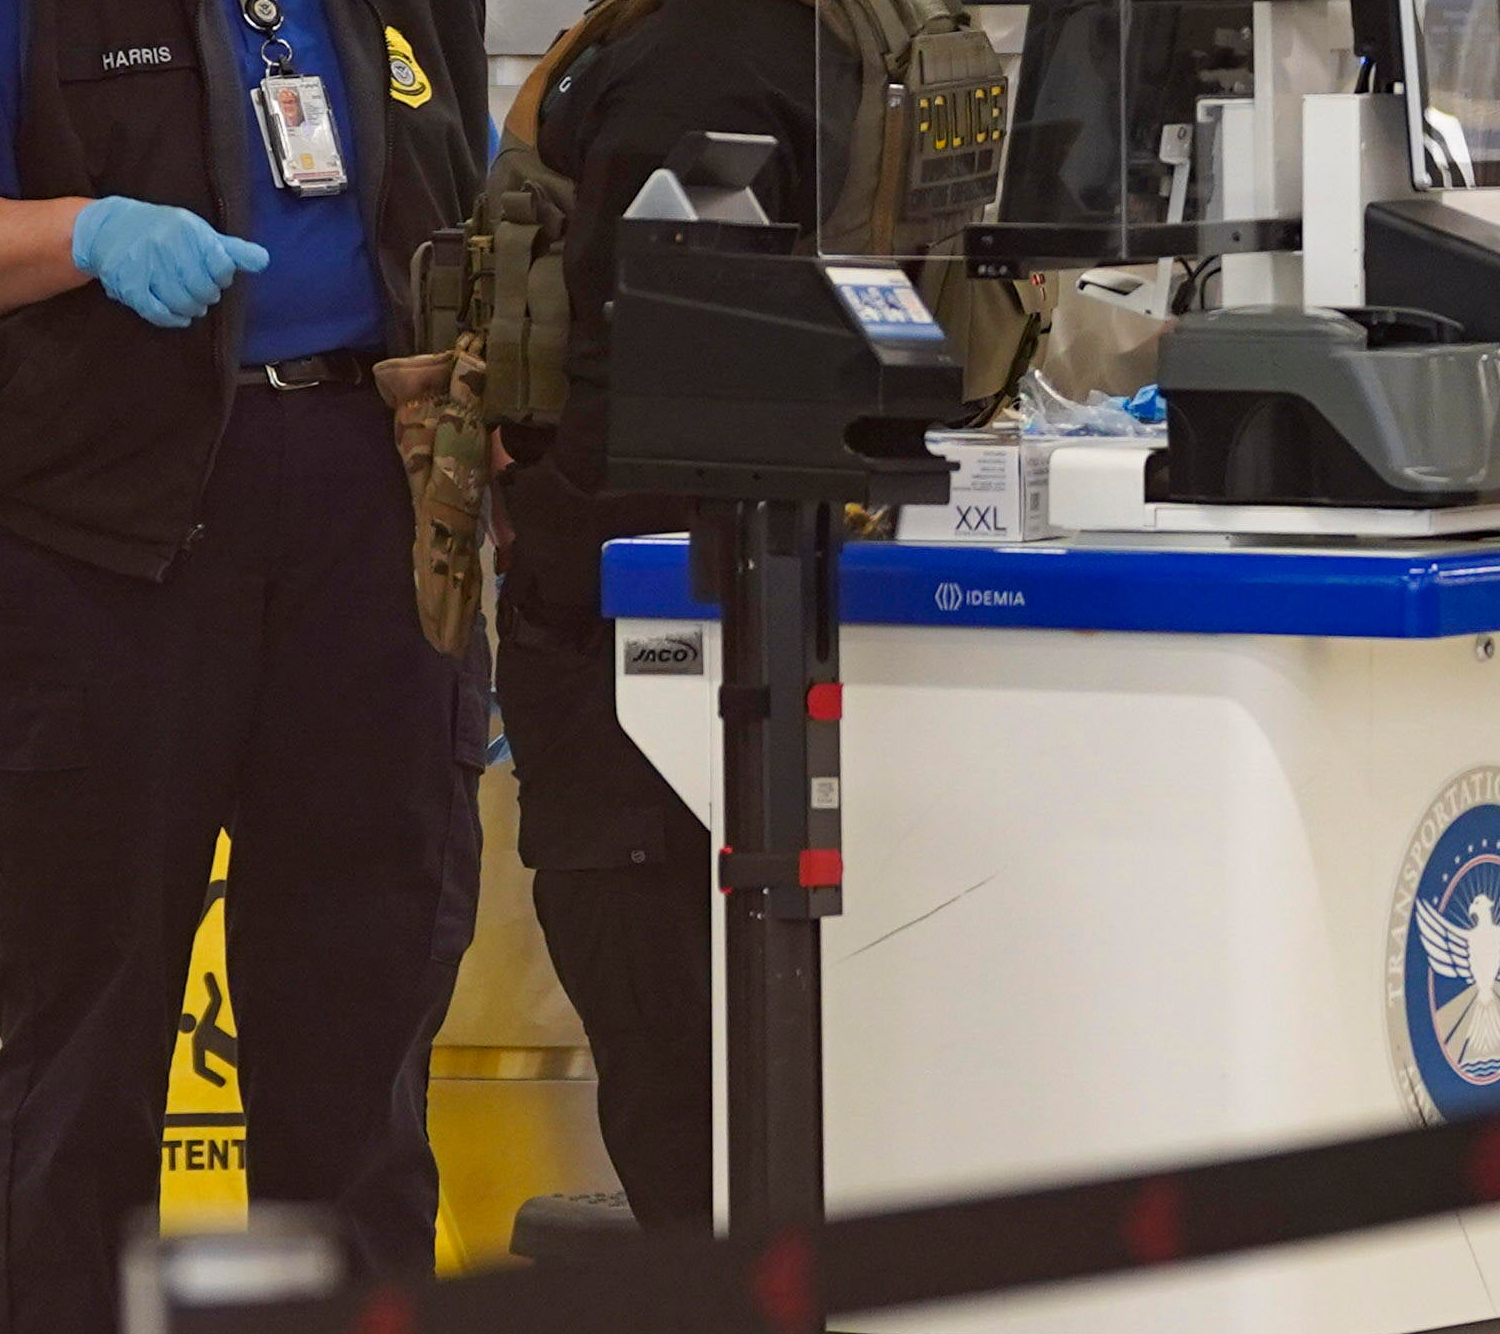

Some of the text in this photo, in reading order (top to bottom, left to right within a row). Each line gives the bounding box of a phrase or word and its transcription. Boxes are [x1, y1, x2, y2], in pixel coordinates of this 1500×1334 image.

[101, 45, 173, 71] HARRIS
[919, 85, 1008, 153] POLICE
[955, 505, 1007, 531] XXL
[965, 590, 1025, 607] IDEMIA
[632, 648, 689, 663] JACO
